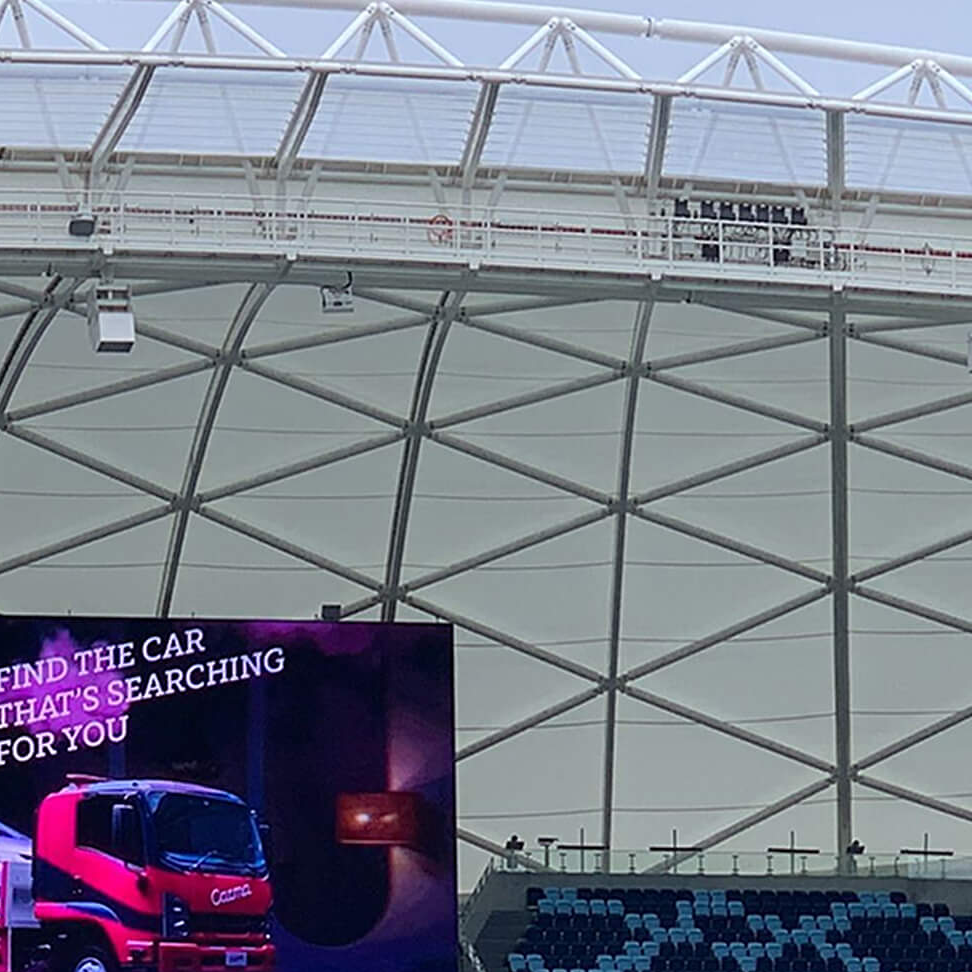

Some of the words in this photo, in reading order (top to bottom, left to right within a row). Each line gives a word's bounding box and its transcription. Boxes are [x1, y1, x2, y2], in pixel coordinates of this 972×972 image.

[74, 641, 135, 676] THE
[142, 628, 206, 660] CAR
[107, 648, 286, 704] SEARCHING
[63, 715, 128, 750] YOU
[210, 883, 252, 906] Carma
